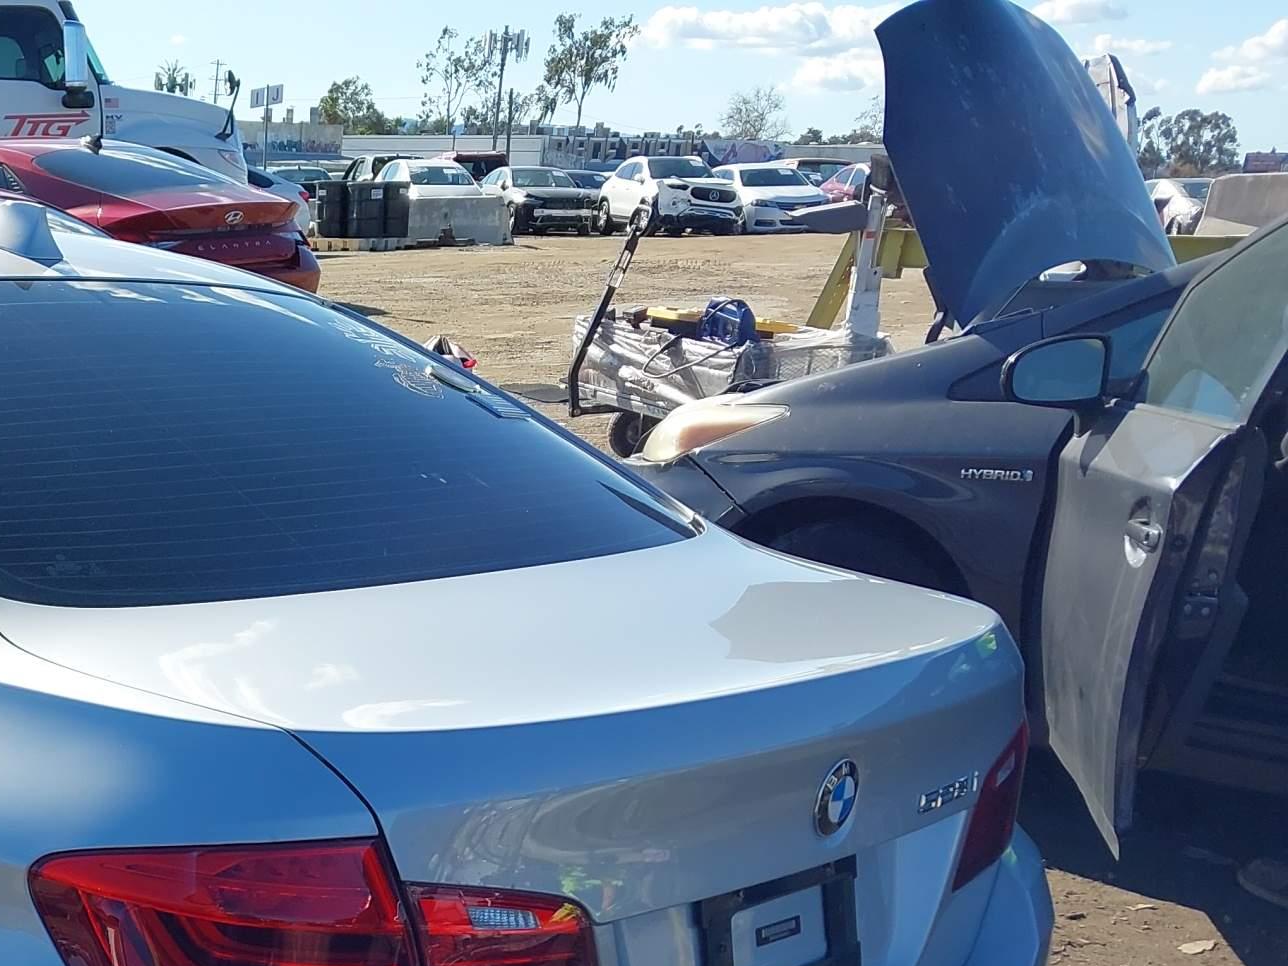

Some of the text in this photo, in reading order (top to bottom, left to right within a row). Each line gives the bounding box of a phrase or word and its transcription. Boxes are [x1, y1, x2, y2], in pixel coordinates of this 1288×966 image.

[271, 87, 280, 102] J
[4, 110, 90, 137] TTG
[197, 240, 272, 251] ELANTRA
[960, 468, 1022, 481] HYBRID
